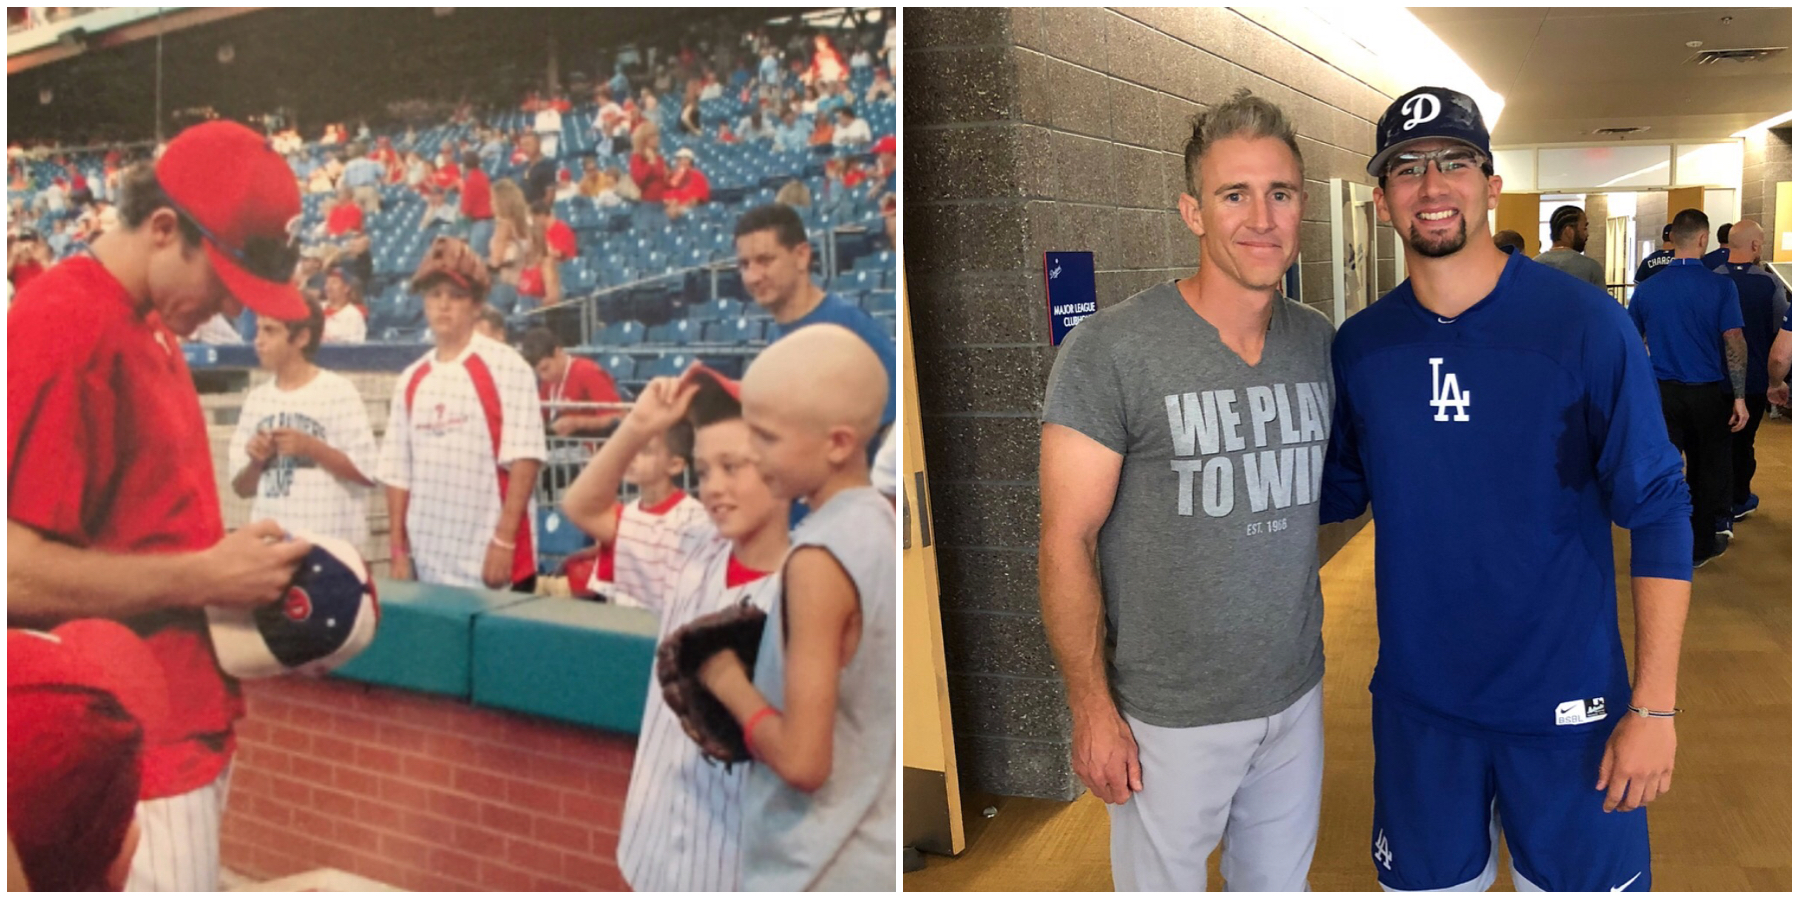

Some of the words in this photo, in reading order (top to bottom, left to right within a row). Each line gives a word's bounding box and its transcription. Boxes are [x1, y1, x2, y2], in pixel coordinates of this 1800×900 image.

[1401, 93, 1441, 131] D
[1053, 303, 1074, 316] MAJOR
[1075, 301, 1096, 314] LEAGUE
[1429, 357, 1470, 422] LA
[1164, 388, 1246, 457] WE
[1170, 456, 1235, 518] TO
[1246, 522, 1264, 536] EST.
[1558, 715, 1584, 724] BSBL
[1374, 828, 1393, 871] LA
